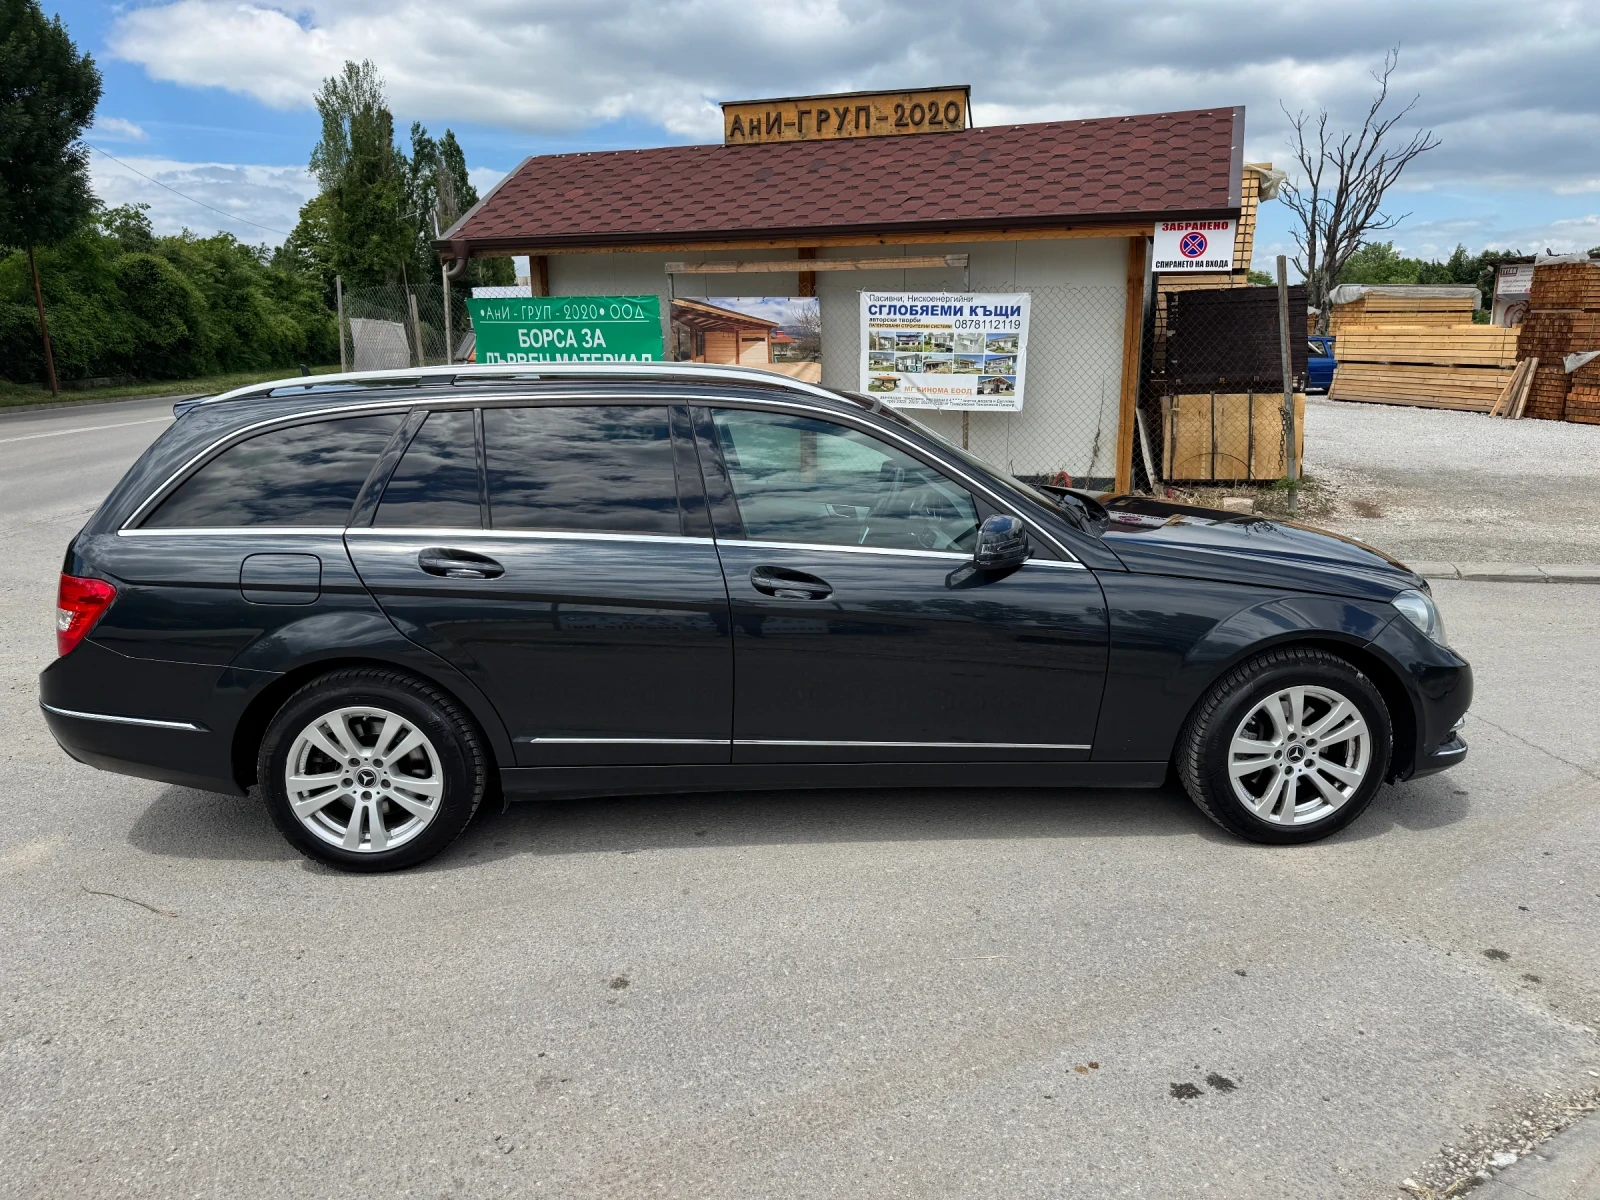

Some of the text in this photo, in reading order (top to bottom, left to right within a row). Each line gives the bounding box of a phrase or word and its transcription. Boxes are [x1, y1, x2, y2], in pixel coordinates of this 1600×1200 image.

[1162, 221, 1229, 231] ЗАБРАНЕНО
[1156, 260, 1229, 268] СПИРАНЕТО НА ВХОДА
[869, 294, 974, 304] Пасивни; Нискоенергийни
[521, 305, 552, 320] ГРУП
[609, 303, 645, 319] ООД
[868, 304, 1022, 319] СГЛОБЯЕМИ КЪЩИ
[954, 319, 1021, 330] 0878112119
[517, 328, 607, 348] БОРСА ЗА
[917, 386, 949, 394] БИНОМА
